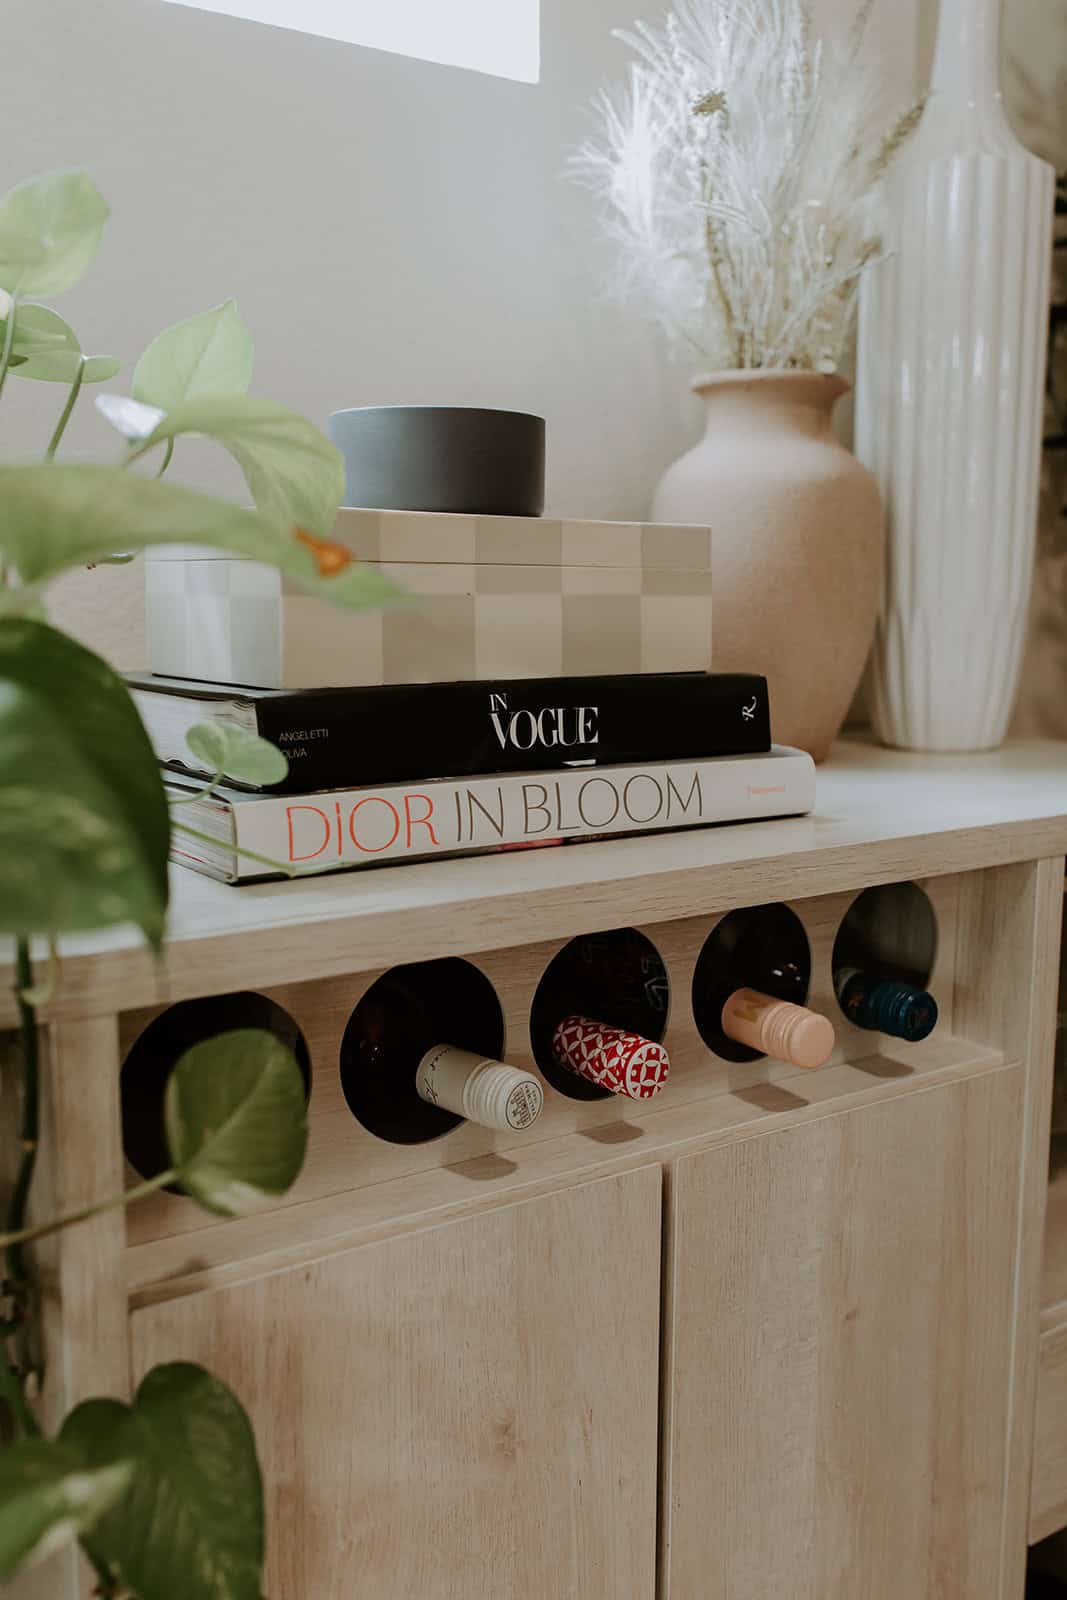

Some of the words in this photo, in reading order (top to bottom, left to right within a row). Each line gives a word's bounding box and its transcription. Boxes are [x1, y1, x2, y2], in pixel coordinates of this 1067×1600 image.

[489, 693, 508, 711] IN
[279, 728, 329, 743] ANGELETTI
[488, 707, 599, 750] VOGUE
[286, 794, 440, 862] DIOR
[454, 786, 504, 842] IN
[521, 771, 703, 835] BLOOM
